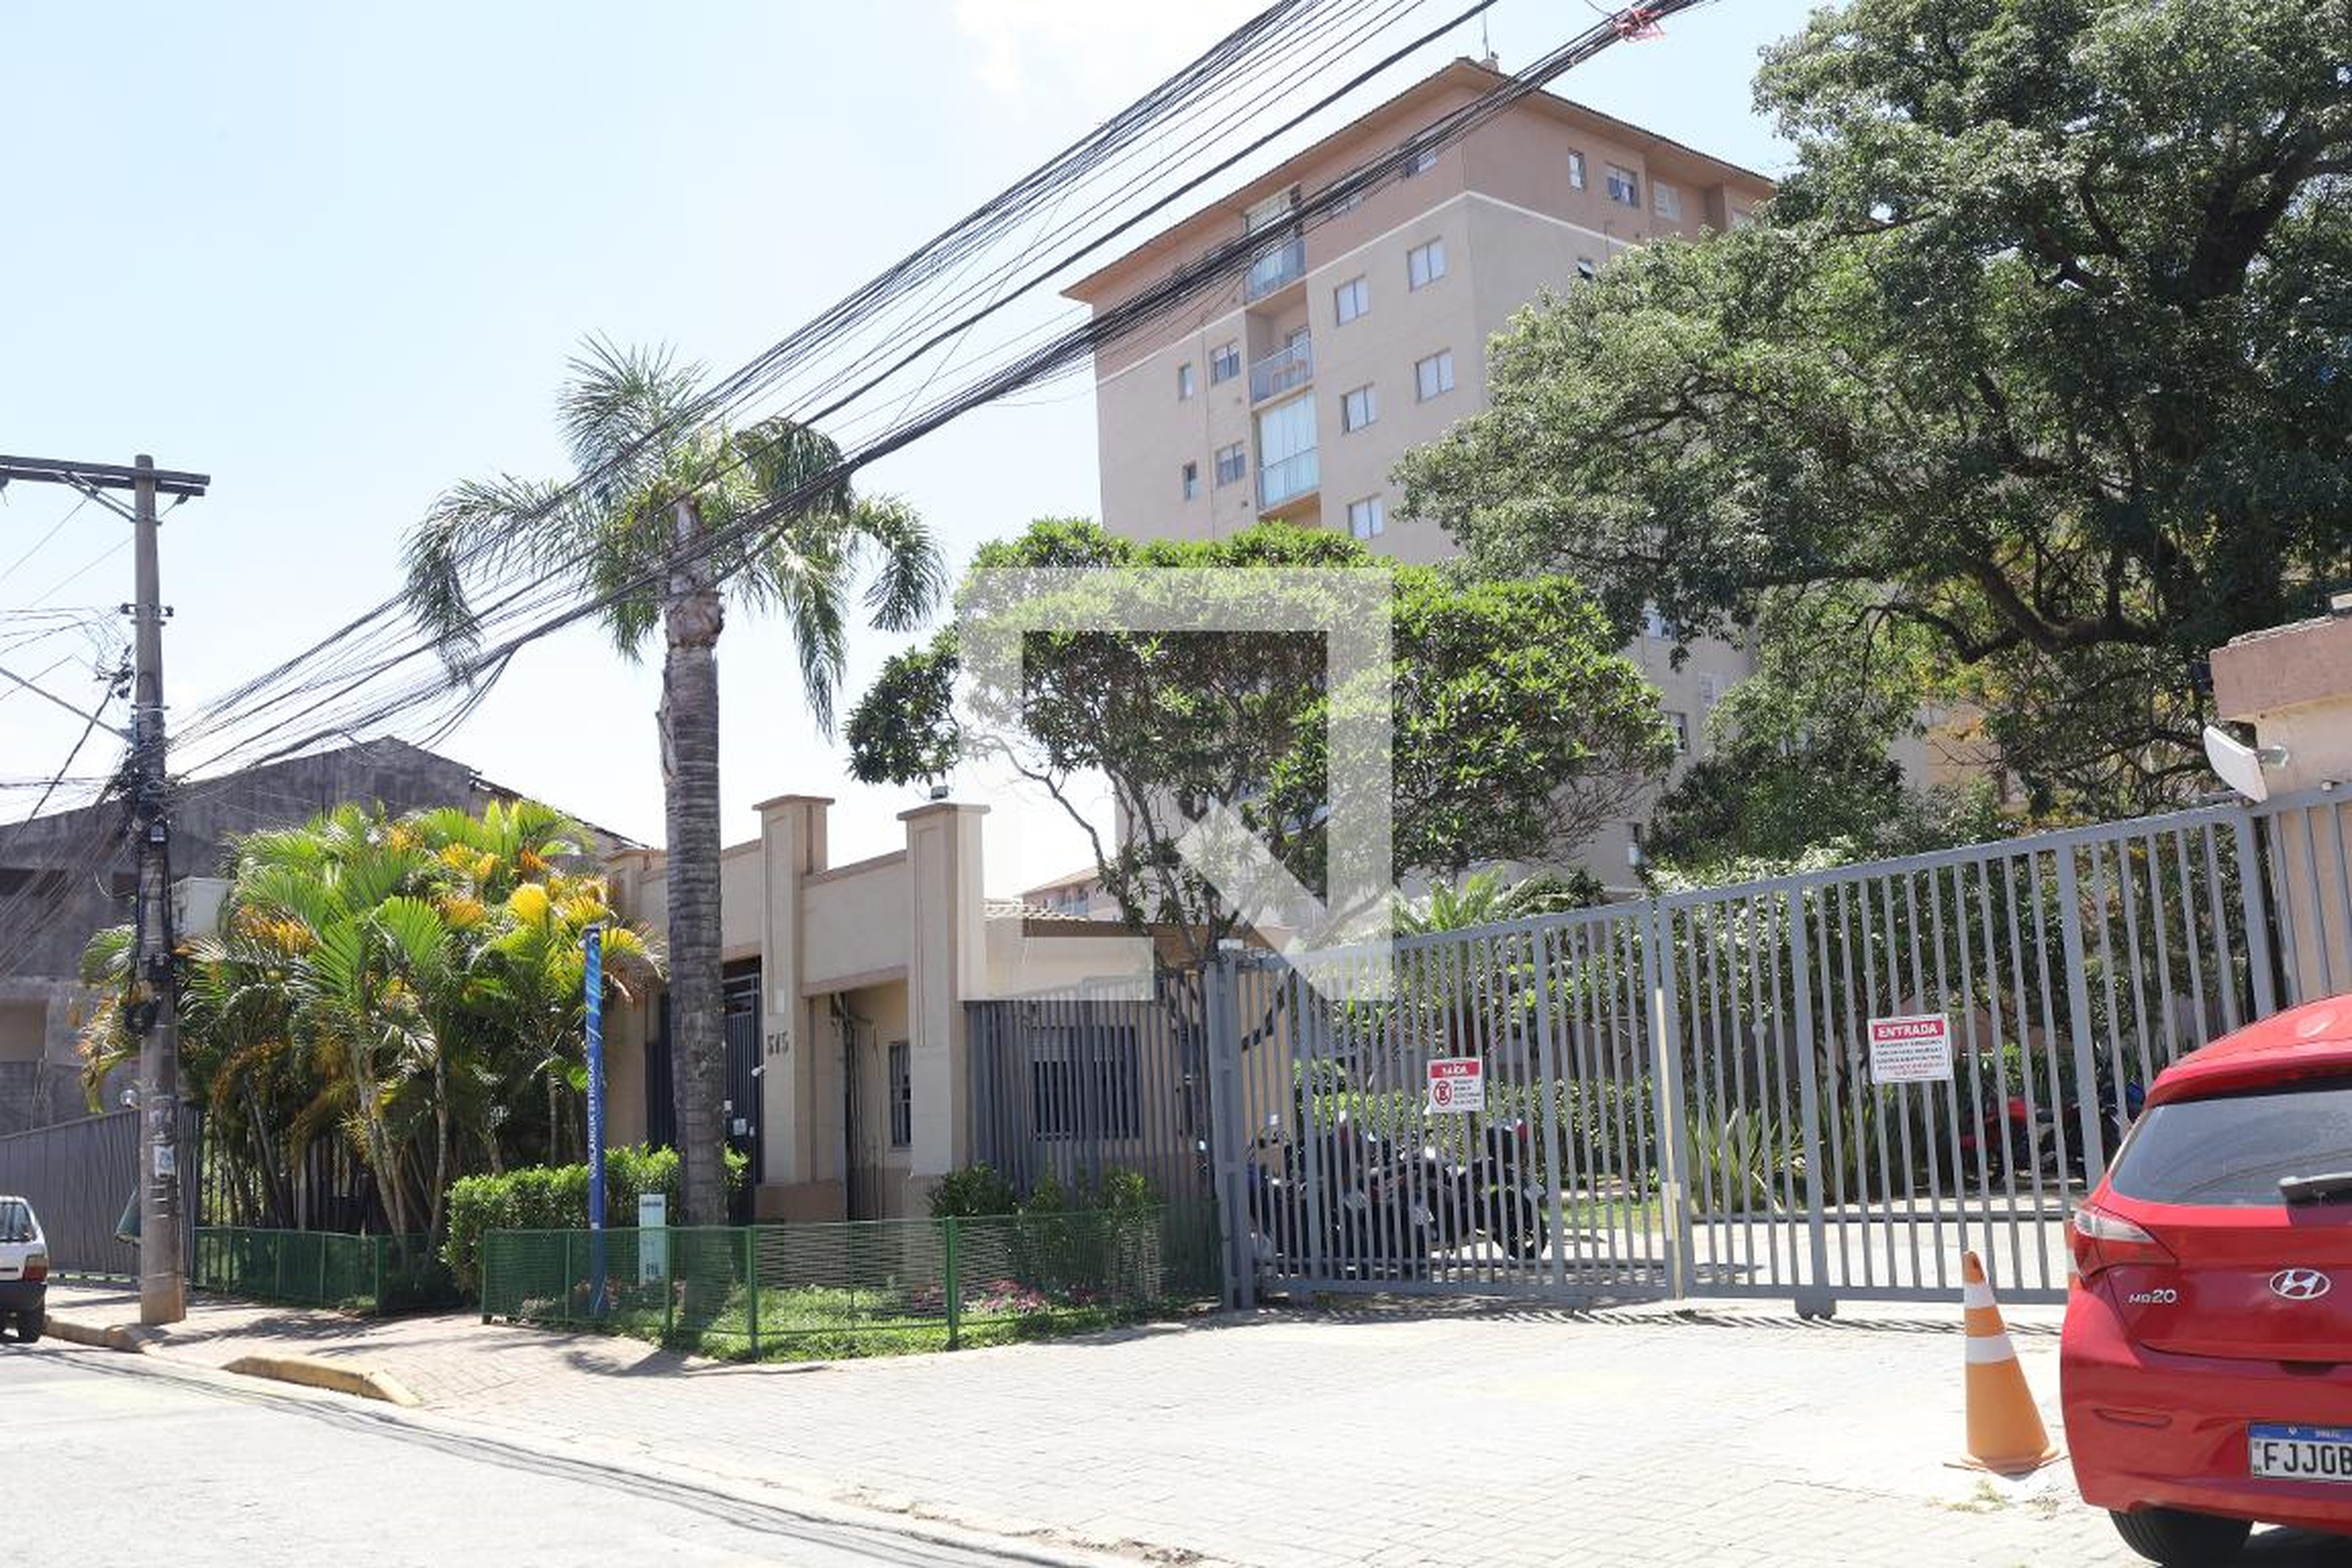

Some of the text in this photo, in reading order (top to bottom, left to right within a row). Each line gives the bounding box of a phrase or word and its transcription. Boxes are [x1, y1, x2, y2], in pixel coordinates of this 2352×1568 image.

[1877, 1023, 1938, 1038] ENTRADA
[767, 1031, 789, 1055] 515
[2129, 1289, 2177, 1303] HB20
